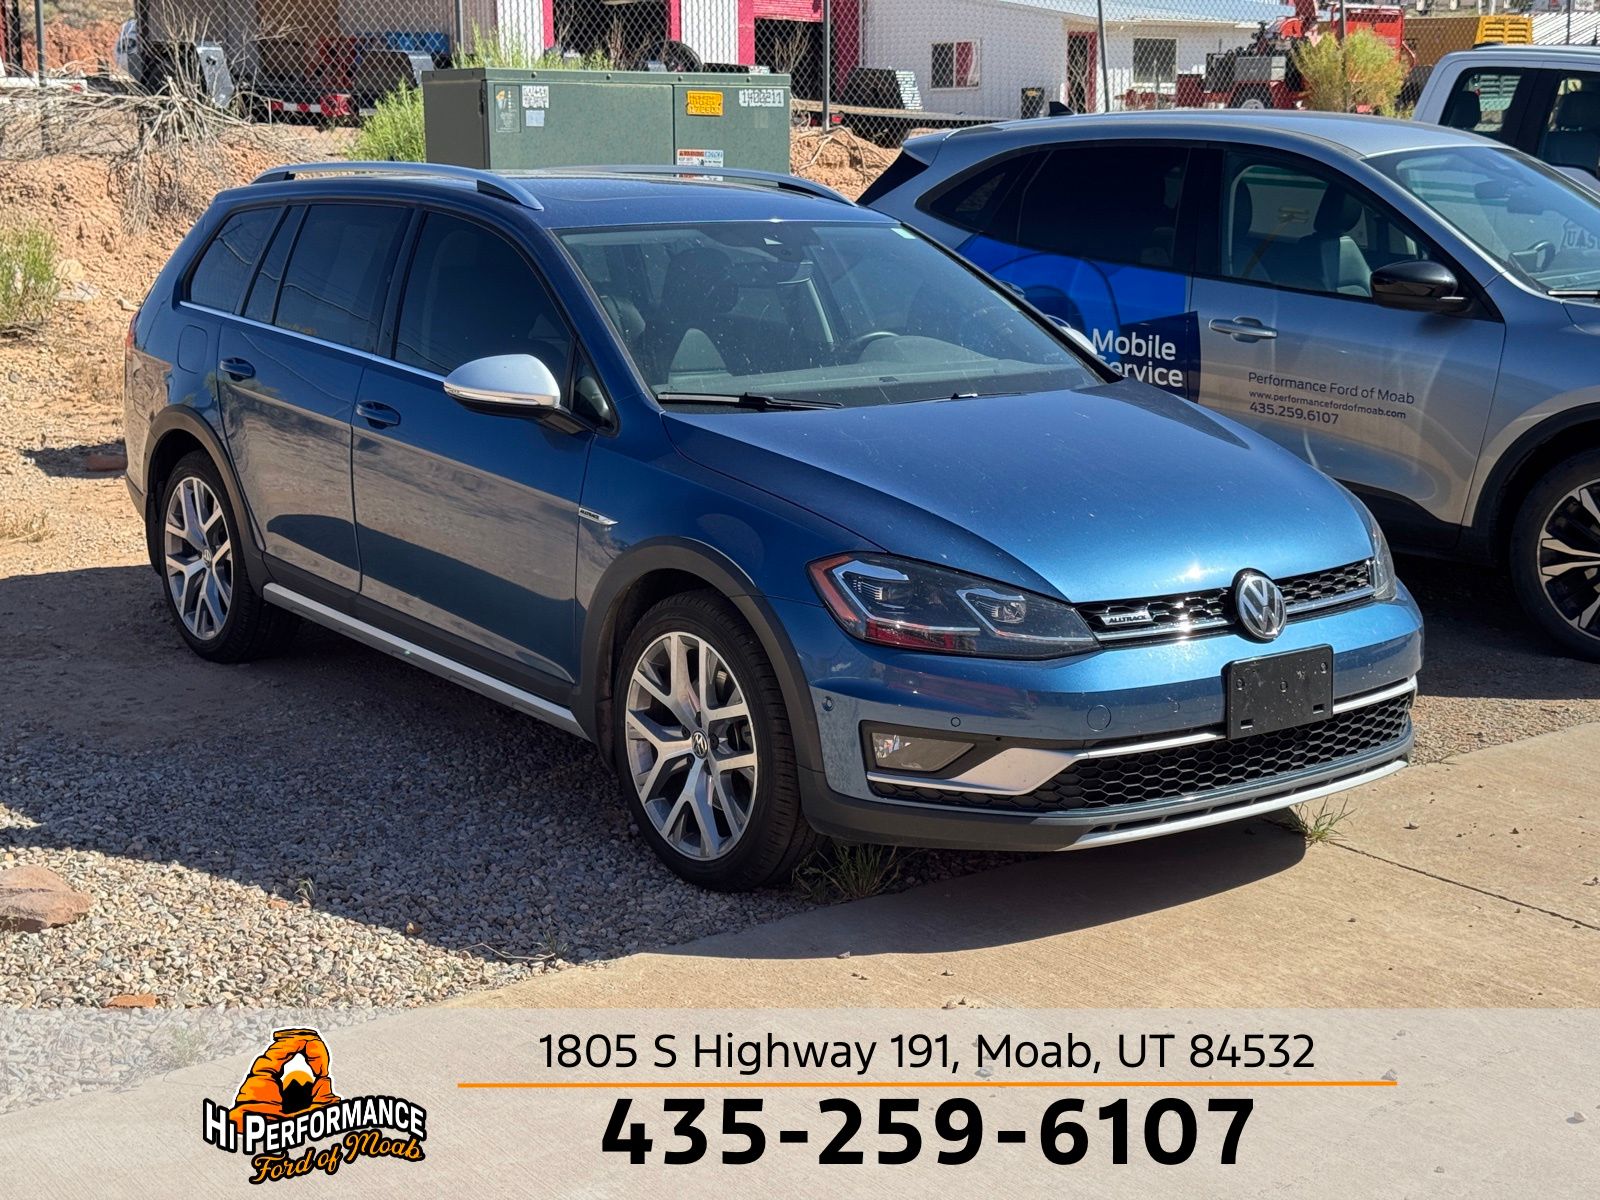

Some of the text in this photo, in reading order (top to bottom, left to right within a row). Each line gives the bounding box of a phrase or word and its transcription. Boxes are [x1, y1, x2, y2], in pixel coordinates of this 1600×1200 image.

[1093, 328, 1176, 361] Mobile
[1248, 372, 1415, 405] Performance Ford of Moab
[1249, 390, 1407, 420] www.performancefordofmoab.com
[1250, 402, 1339, 425] 435.259.6107
